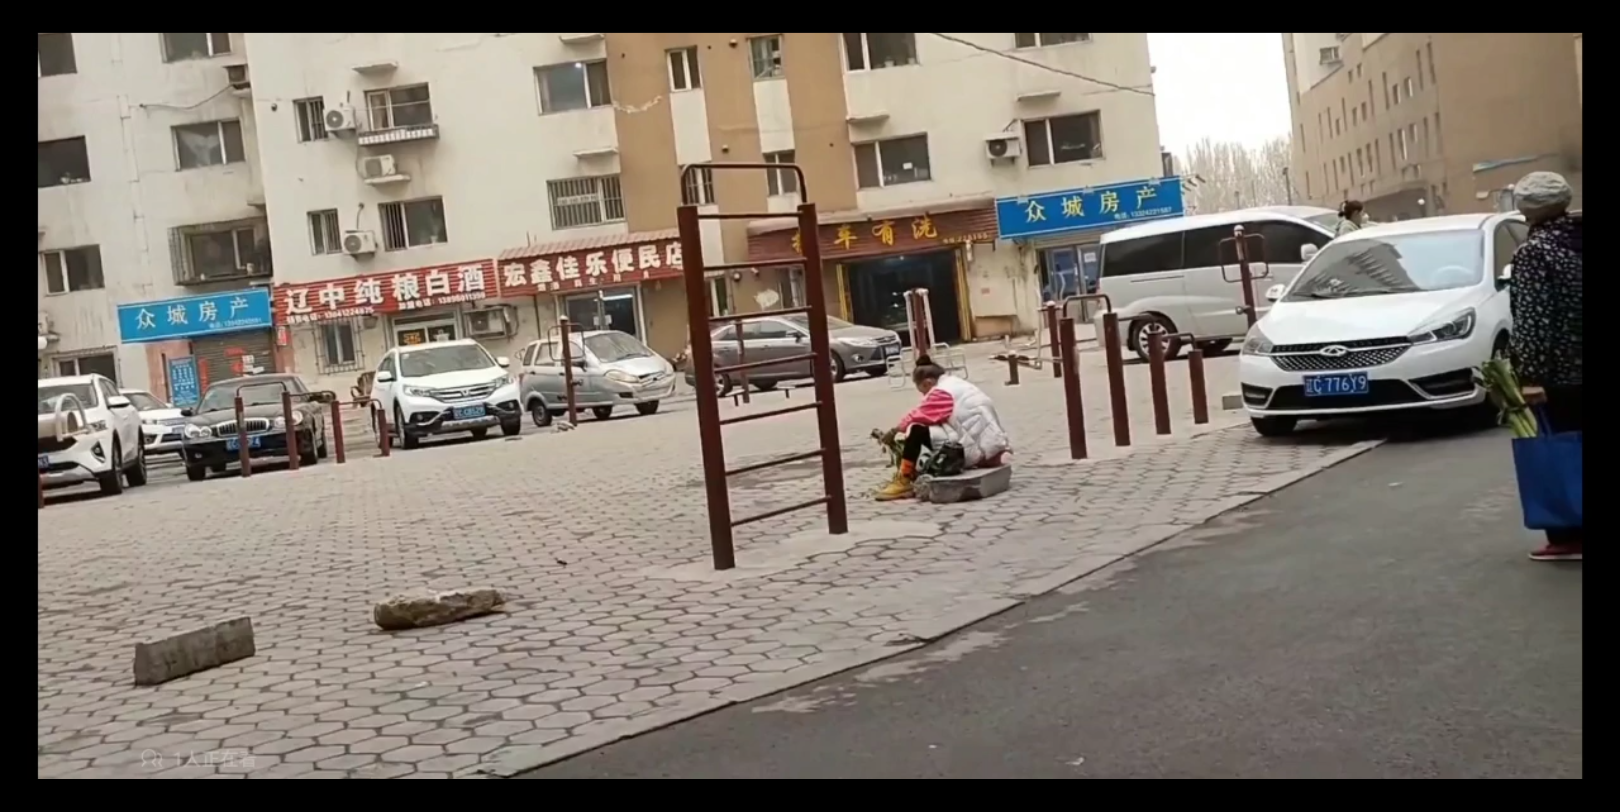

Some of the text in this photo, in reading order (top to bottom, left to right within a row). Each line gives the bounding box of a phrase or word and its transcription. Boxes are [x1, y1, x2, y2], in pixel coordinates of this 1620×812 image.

[1024, 185, 1158, 224] 众城房产
[503, 241, 683, 288] 宏鑫佳乐便民店
[283, 264, 485, 316] 辽中纯粮白酒
[134, 296, 250, 331] 众城房产
